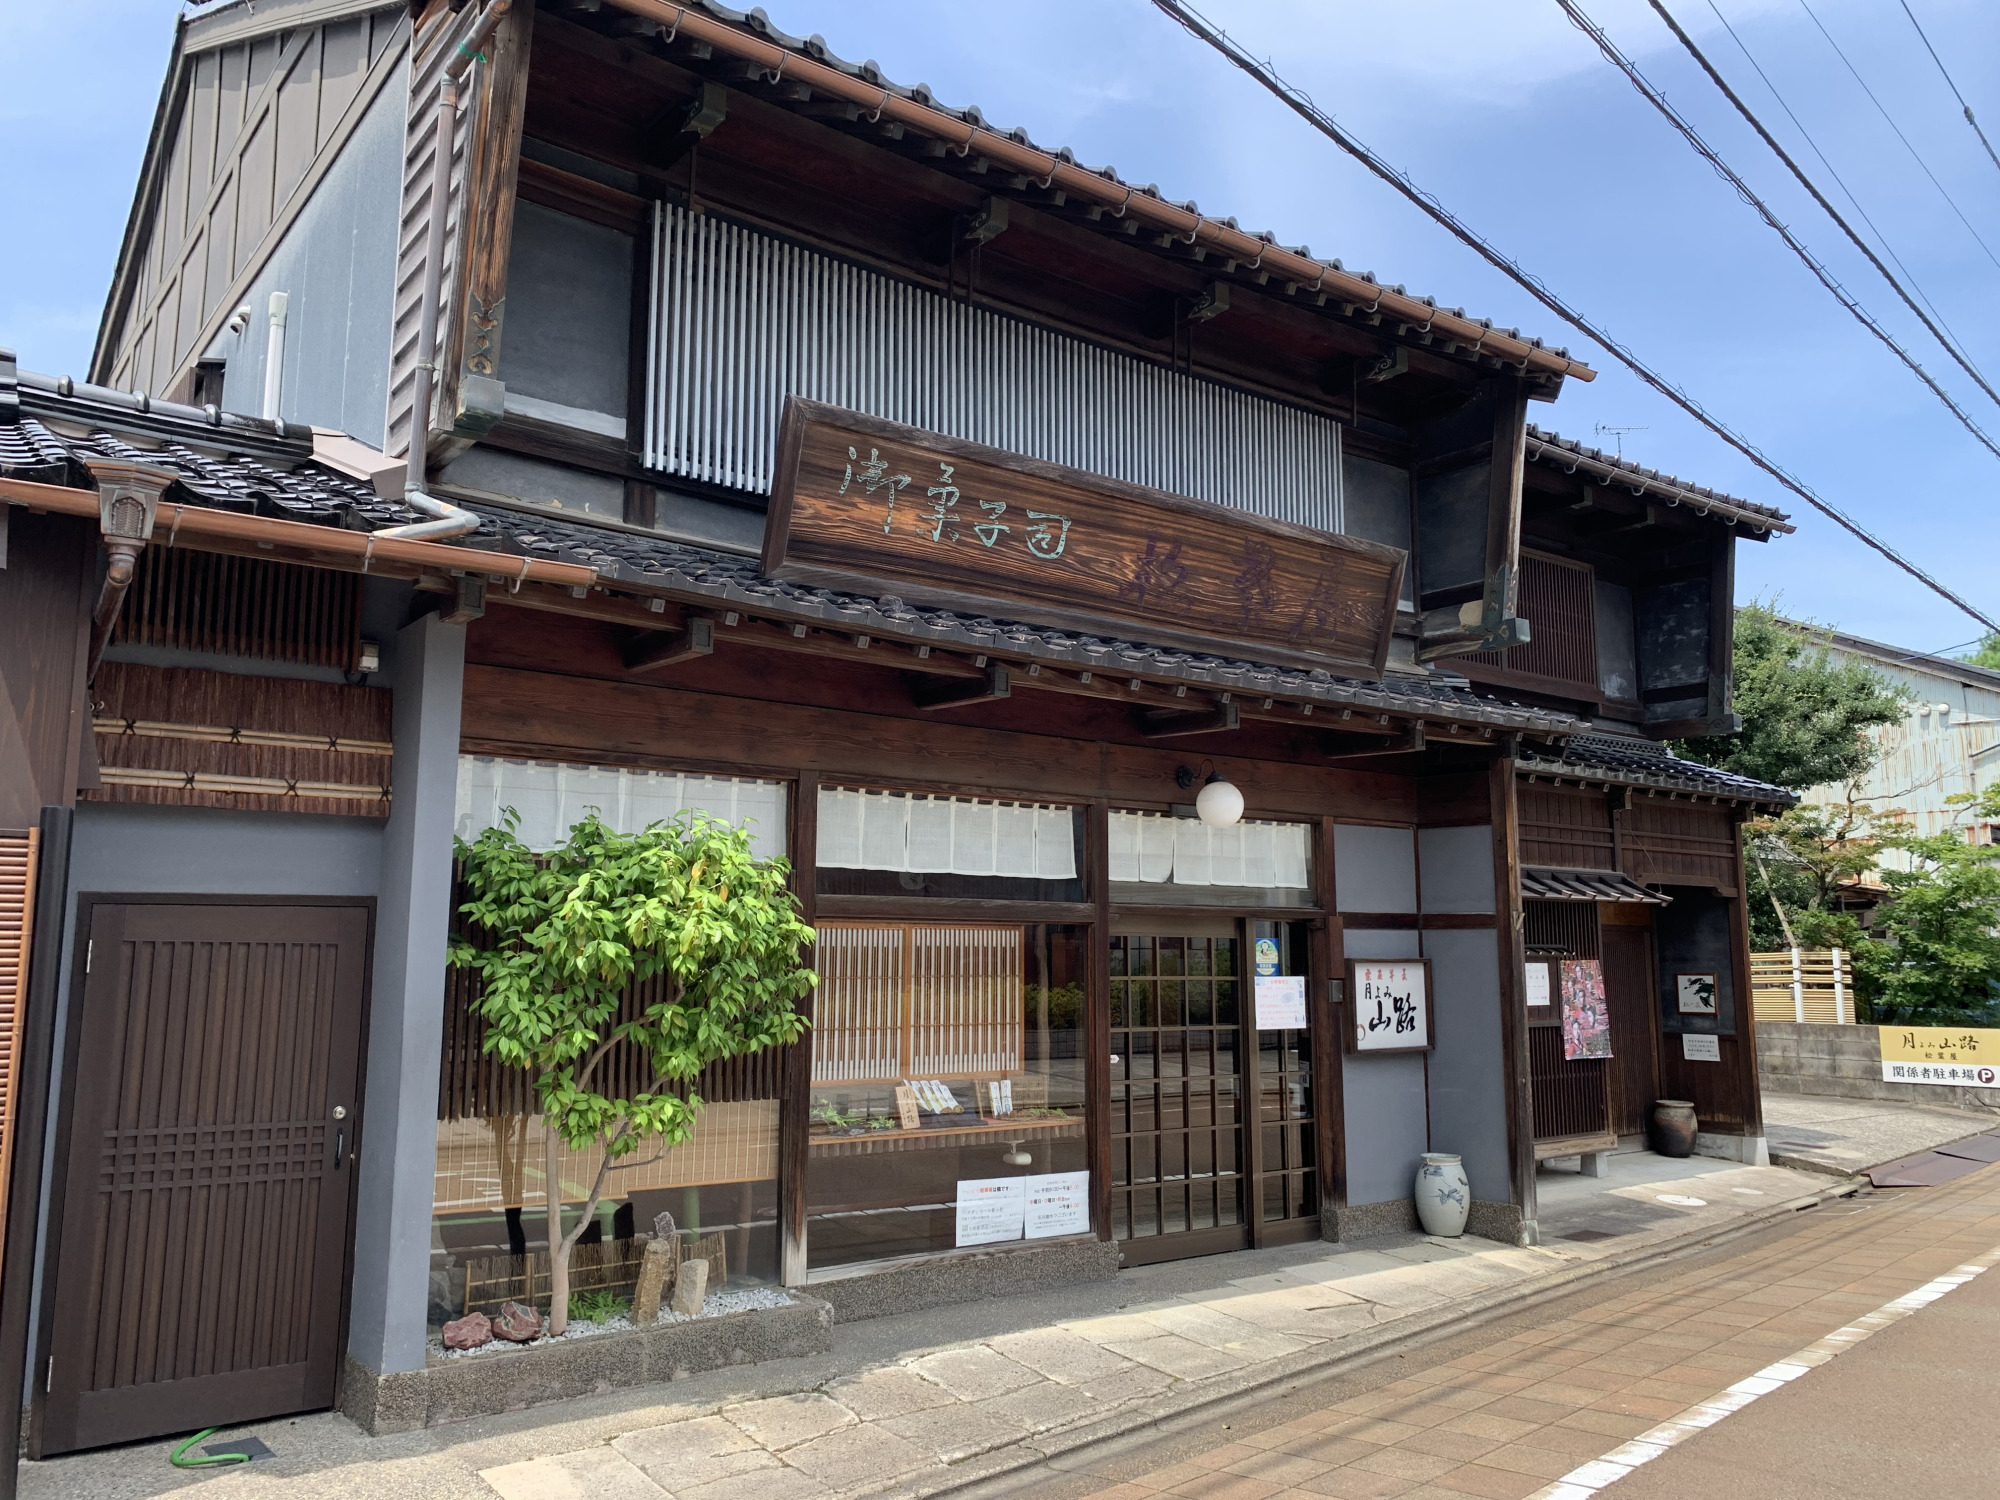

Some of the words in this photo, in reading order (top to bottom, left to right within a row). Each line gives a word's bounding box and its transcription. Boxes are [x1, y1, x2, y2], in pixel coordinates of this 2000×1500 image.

[1364, 982, 1393, 999] 月よみ
[1368, 992, 1417, 1034] 山路
[1902, 1032, 1979, 1051] 月よみ山路
[1925, 1051, 1958, 1061] 松葉屋
[1892, 1065, 1975, 1081] 関係者駐車場
